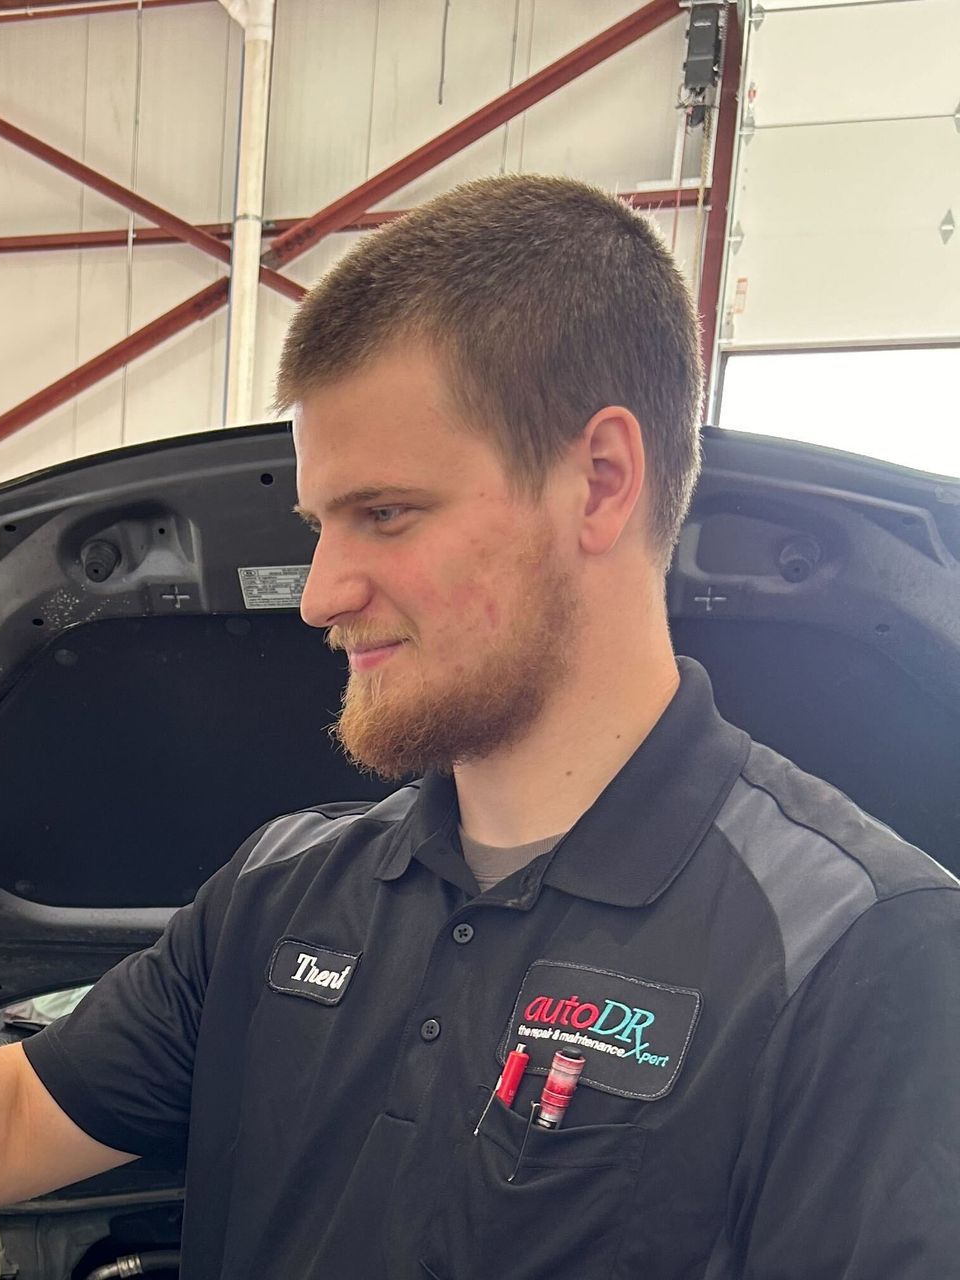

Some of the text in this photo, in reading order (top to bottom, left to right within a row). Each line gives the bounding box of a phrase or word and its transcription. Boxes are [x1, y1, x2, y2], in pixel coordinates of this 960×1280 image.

[291, 953, 352, 990] Trent
[530, 1027, 551, 1039] repair
[552, 1028, 559, 1039] &
[559, 1031, 625, 1058] maintenance
